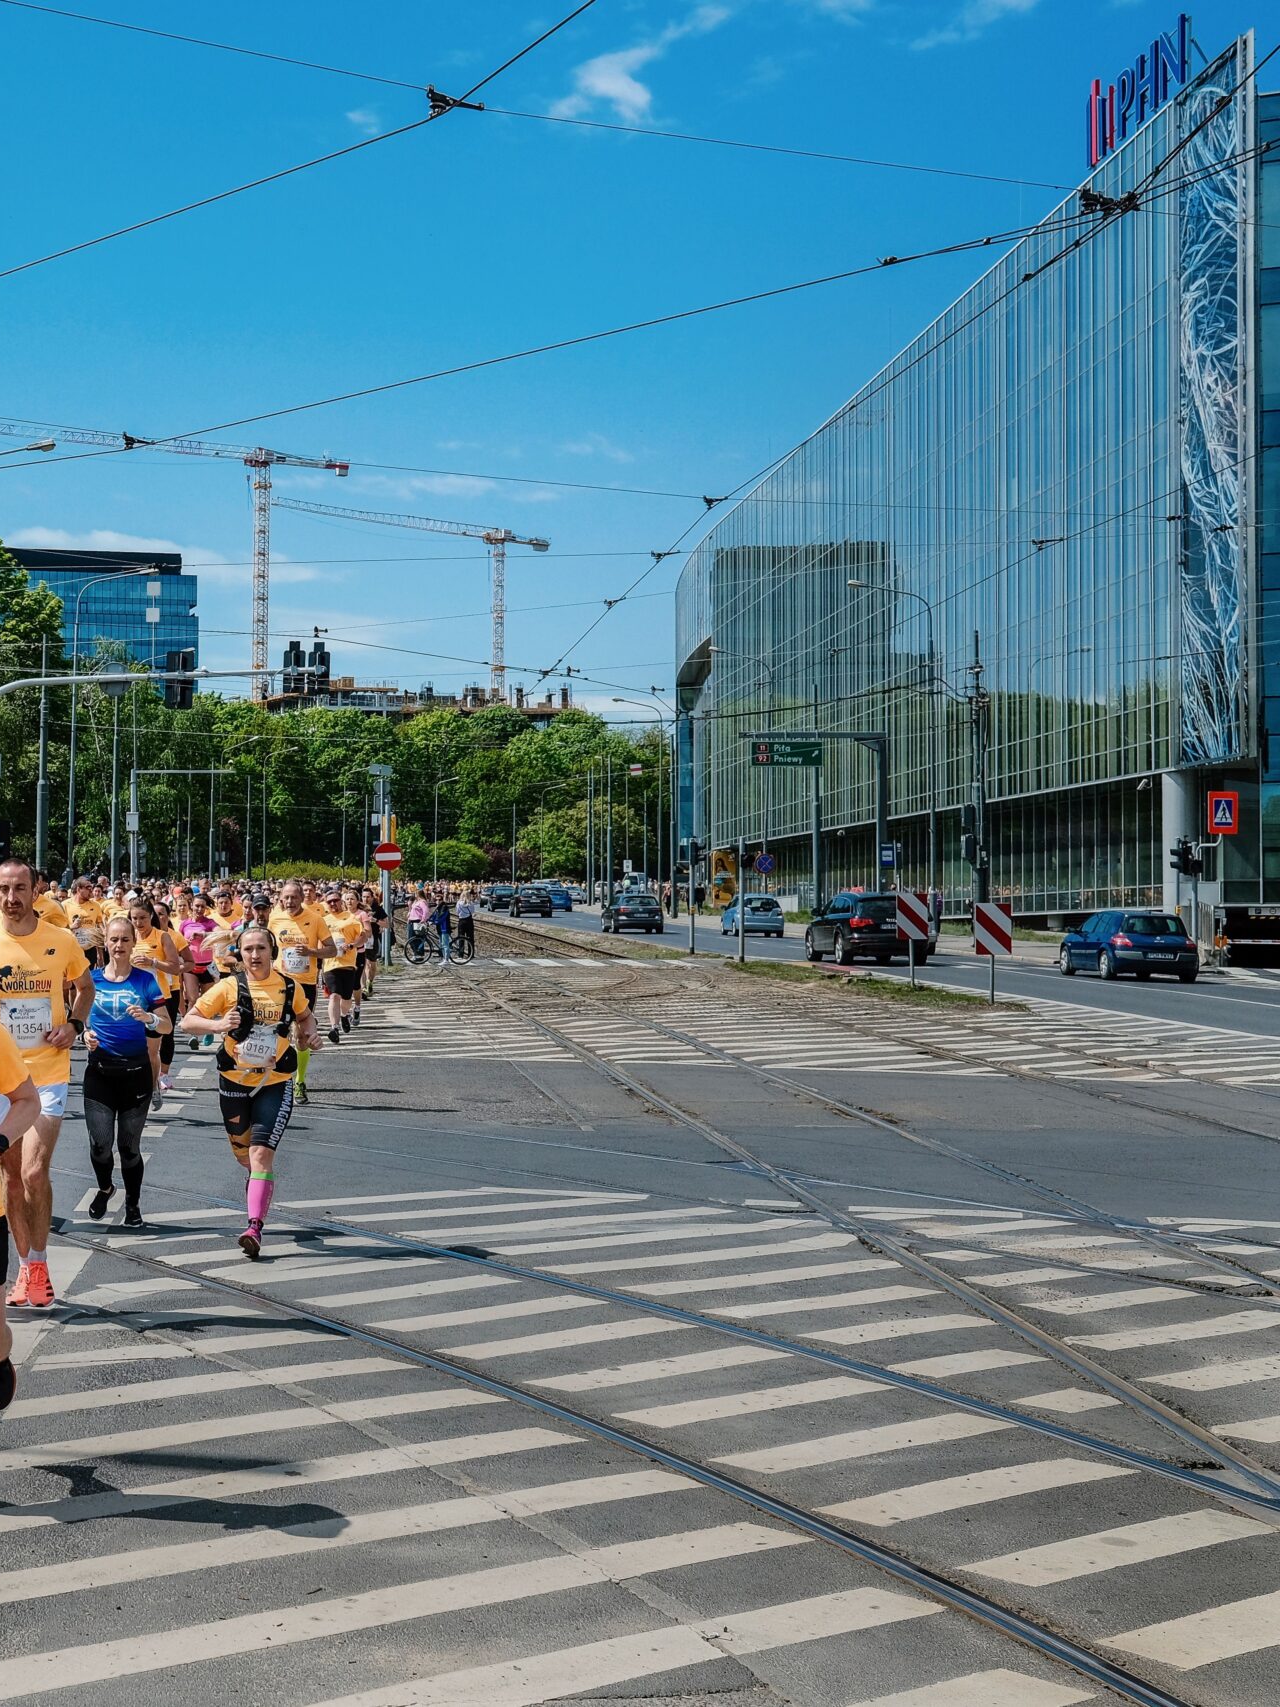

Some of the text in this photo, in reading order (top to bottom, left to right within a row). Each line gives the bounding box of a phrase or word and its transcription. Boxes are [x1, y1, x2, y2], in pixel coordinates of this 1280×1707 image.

[1115, 13, 1187, 141] PHN
[773, 744, 791, 752] Piła
[773, 755, 803, 764] Pniewy
[4, 979, 52, 991] WORLD RUN
[253, 1010, 274, 1019] ORLD
[8, 1023, 43, 1034] 11354
[242, 1042, 270, 1055] 10187
[267, 1080, 293, 1148] RUNMAGEDDON
